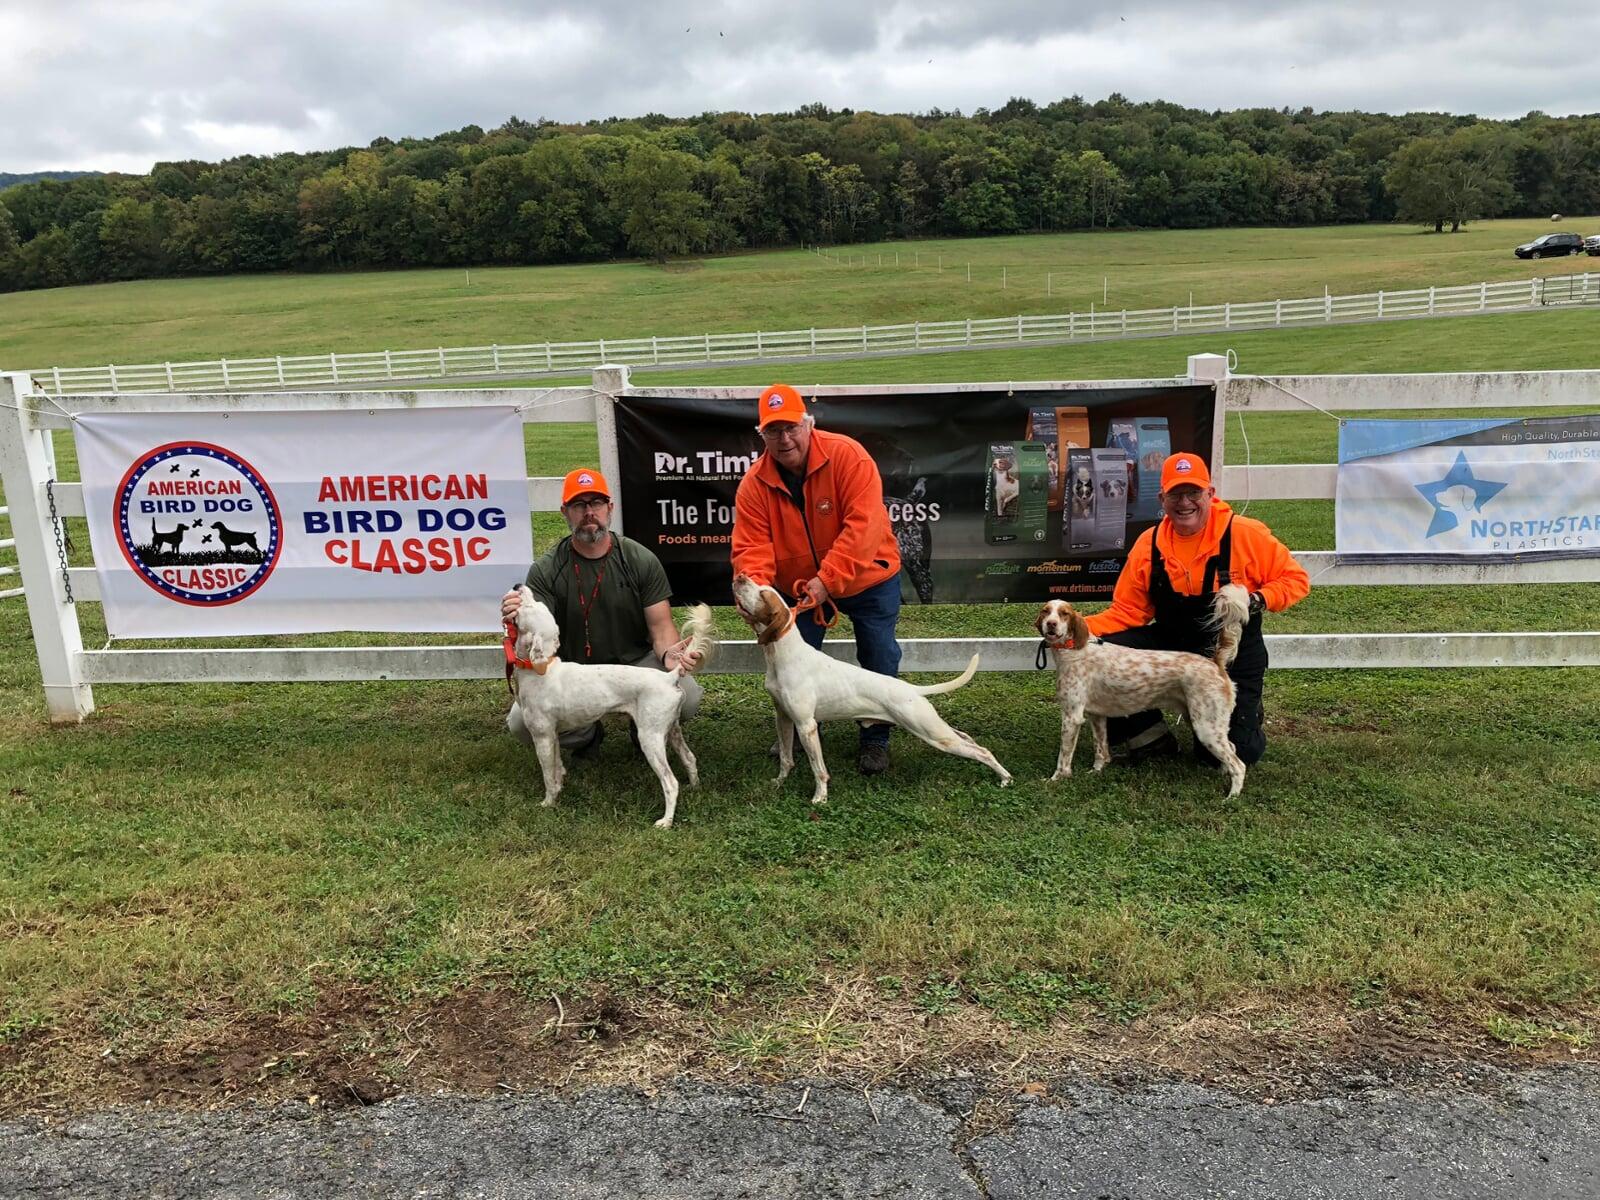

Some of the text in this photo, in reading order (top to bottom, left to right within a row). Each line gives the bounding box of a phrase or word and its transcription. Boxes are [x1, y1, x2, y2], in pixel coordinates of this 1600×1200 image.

[1502, 429, 1599, 442] High Quality, Durable
[654, 451, 694, 474] Dr.
[147, 480, 242, 496] AMERICAN
[318, 474, 489, 502] AMERICAN
[140, 498, 253, 514] BIRD DOG
[656, 499, 699, 525] The
[303, 507, 507, 534] BIRD DOG
[658, 534, 697, 544] Foods
[324, 536, 492, 575] CLASSIC
[1027, 563, 1082, 573] momentum
[1088, 560, 1121, 571] fusion
[162, 568, 247, 590] CLASSIC
[1048, 584, 1114, 593] www.drtims.com
